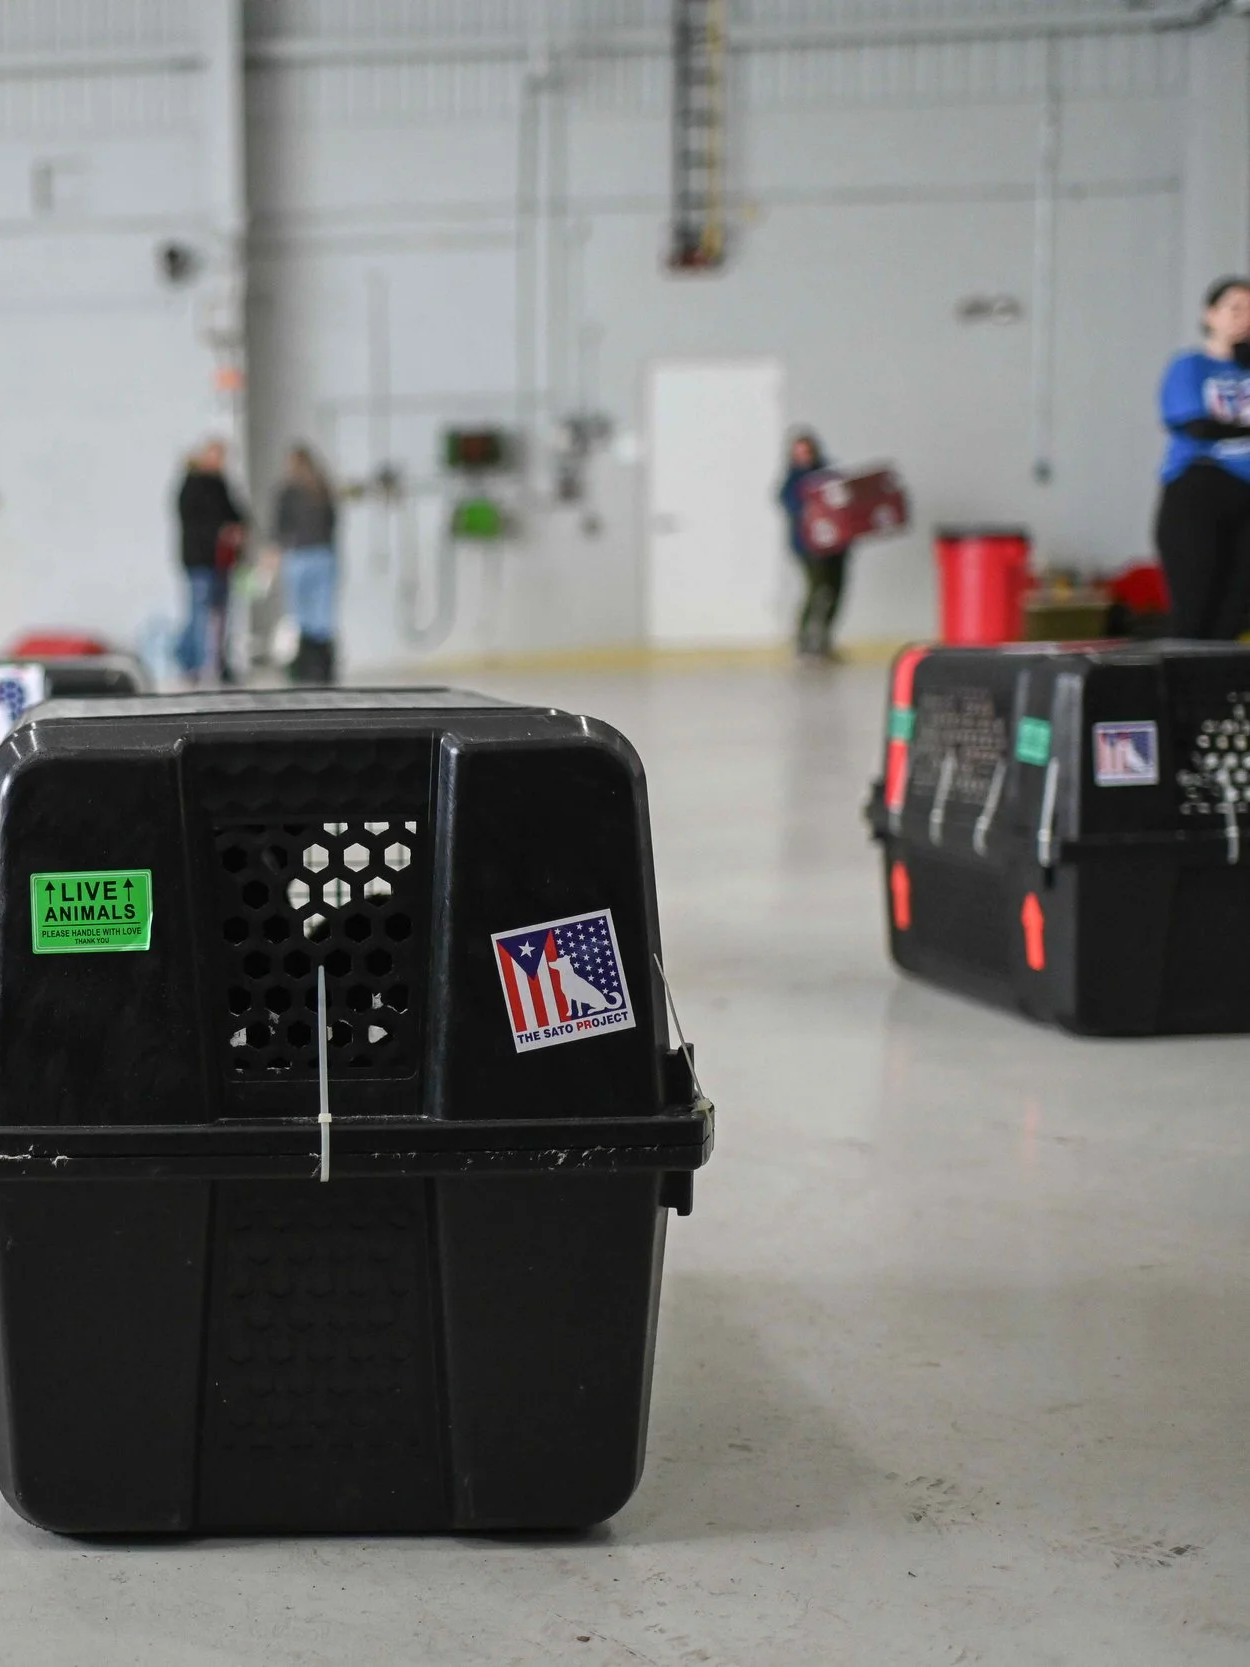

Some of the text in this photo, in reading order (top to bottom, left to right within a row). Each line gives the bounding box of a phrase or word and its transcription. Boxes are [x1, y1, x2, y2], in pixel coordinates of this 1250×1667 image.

[61, 881, 117, 901] LIVE
[45, 904, 135, 922] ANIMALS
[42, 927, 141, 938] PLEASE HANDLE WITH LOVE
[517, 1012, 628, 1044] THE SATO PROJECT
